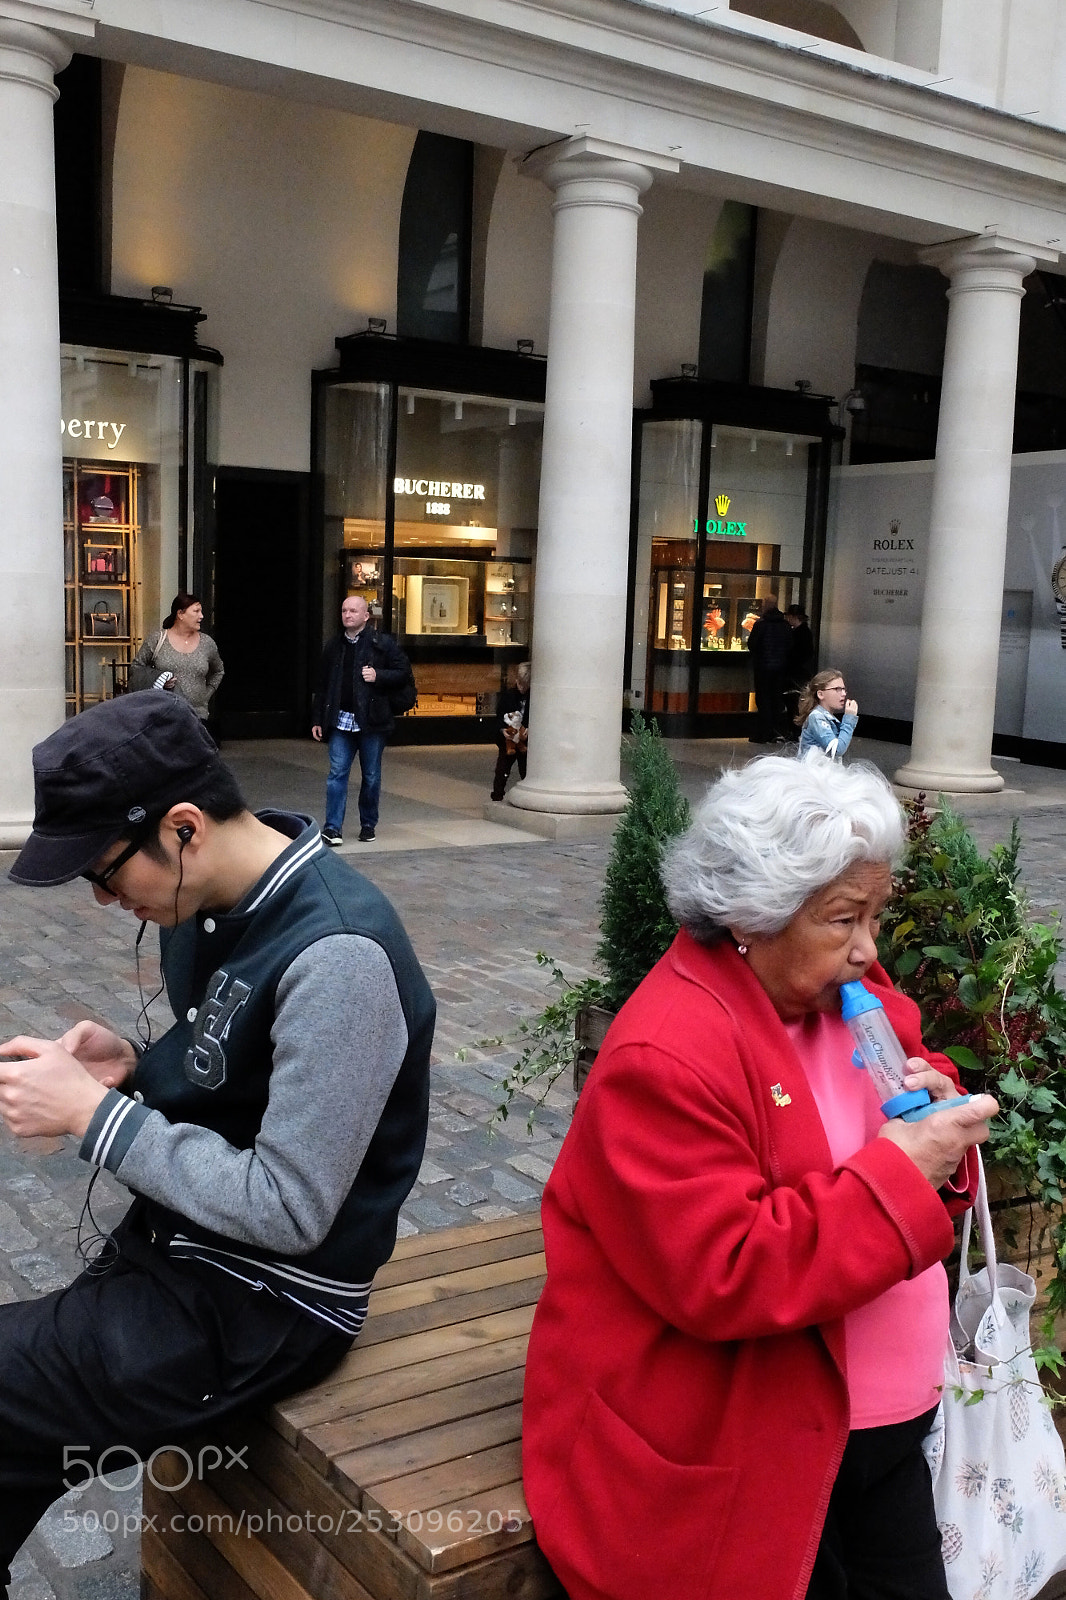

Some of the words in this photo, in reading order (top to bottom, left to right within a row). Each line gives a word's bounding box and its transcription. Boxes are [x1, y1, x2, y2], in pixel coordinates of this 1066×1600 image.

[61, 418, 127, 449] erry
[394, 477, 486, 500] BUCHERER
[873, 538, 914, 551] ROLEX
